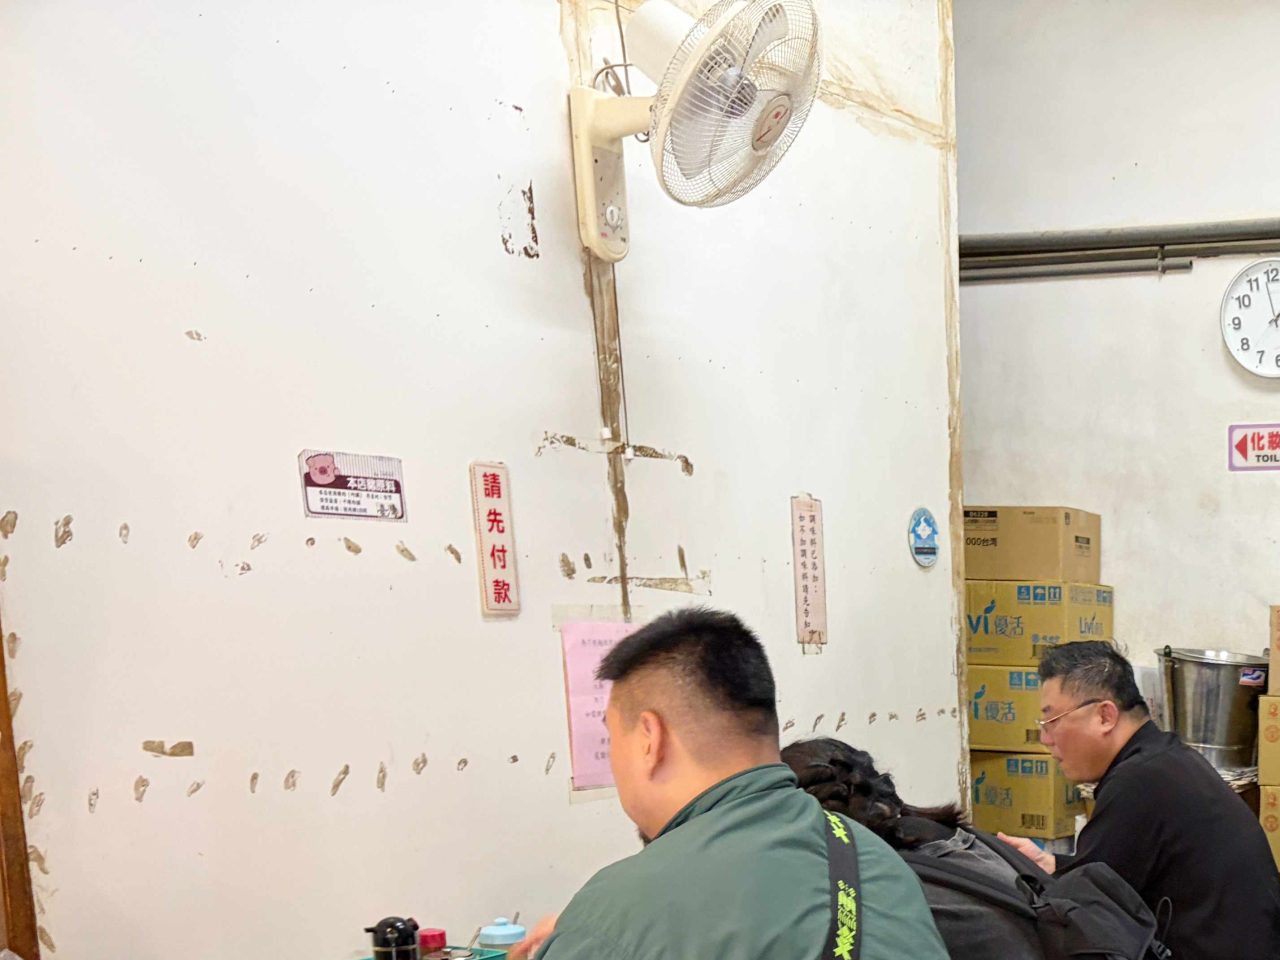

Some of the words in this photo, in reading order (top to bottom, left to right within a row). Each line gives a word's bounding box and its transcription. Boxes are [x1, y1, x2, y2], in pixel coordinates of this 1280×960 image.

[1263, 268, 1280, 282] 12
[1246, 277, 1260, 291] 11
[1235, 294, 1251, 309] 10
[1232, 317, 1242, 330] 9
[1240, 338, 1250, 351] 8
[1256, 350, 1265, 364] 7
[482, 472, 512, 604] 請先付款
